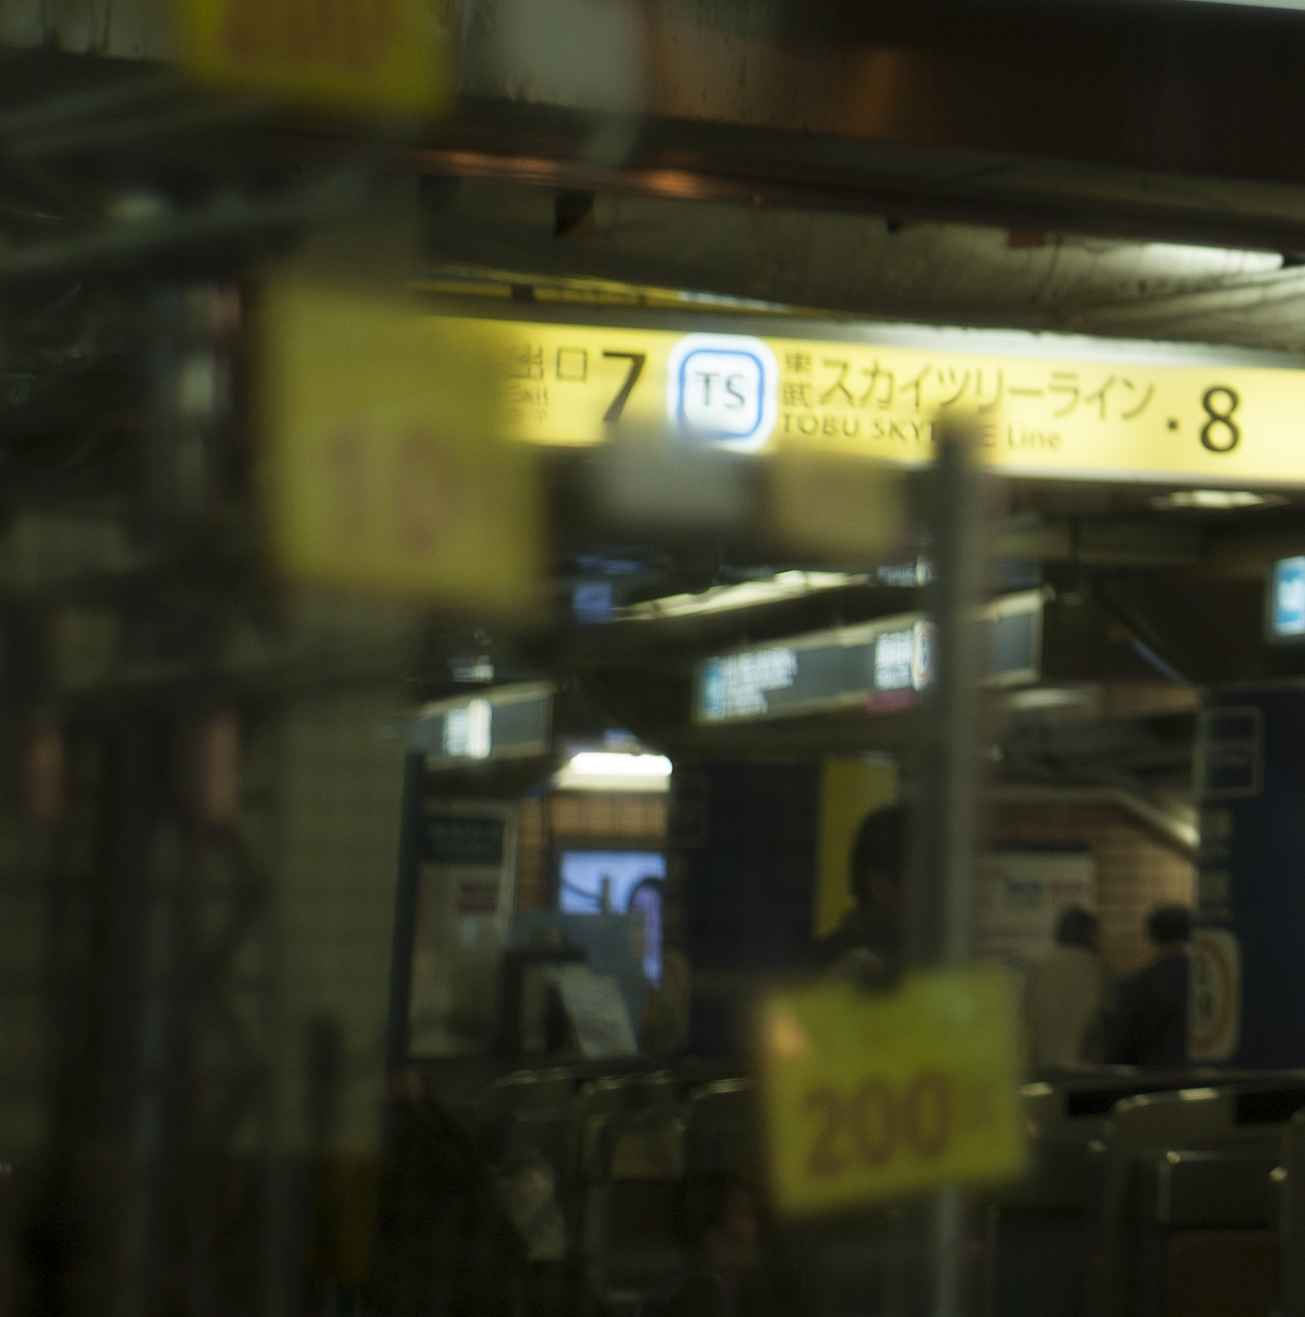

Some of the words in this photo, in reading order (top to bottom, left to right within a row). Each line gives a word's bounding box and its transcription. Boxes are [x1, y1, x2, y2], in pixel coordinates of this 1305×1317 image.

[782, 413, 861, 437] TOBU
[1007, 424, 1064, 450] Line
[805, 1066, 952, 1177] 200
